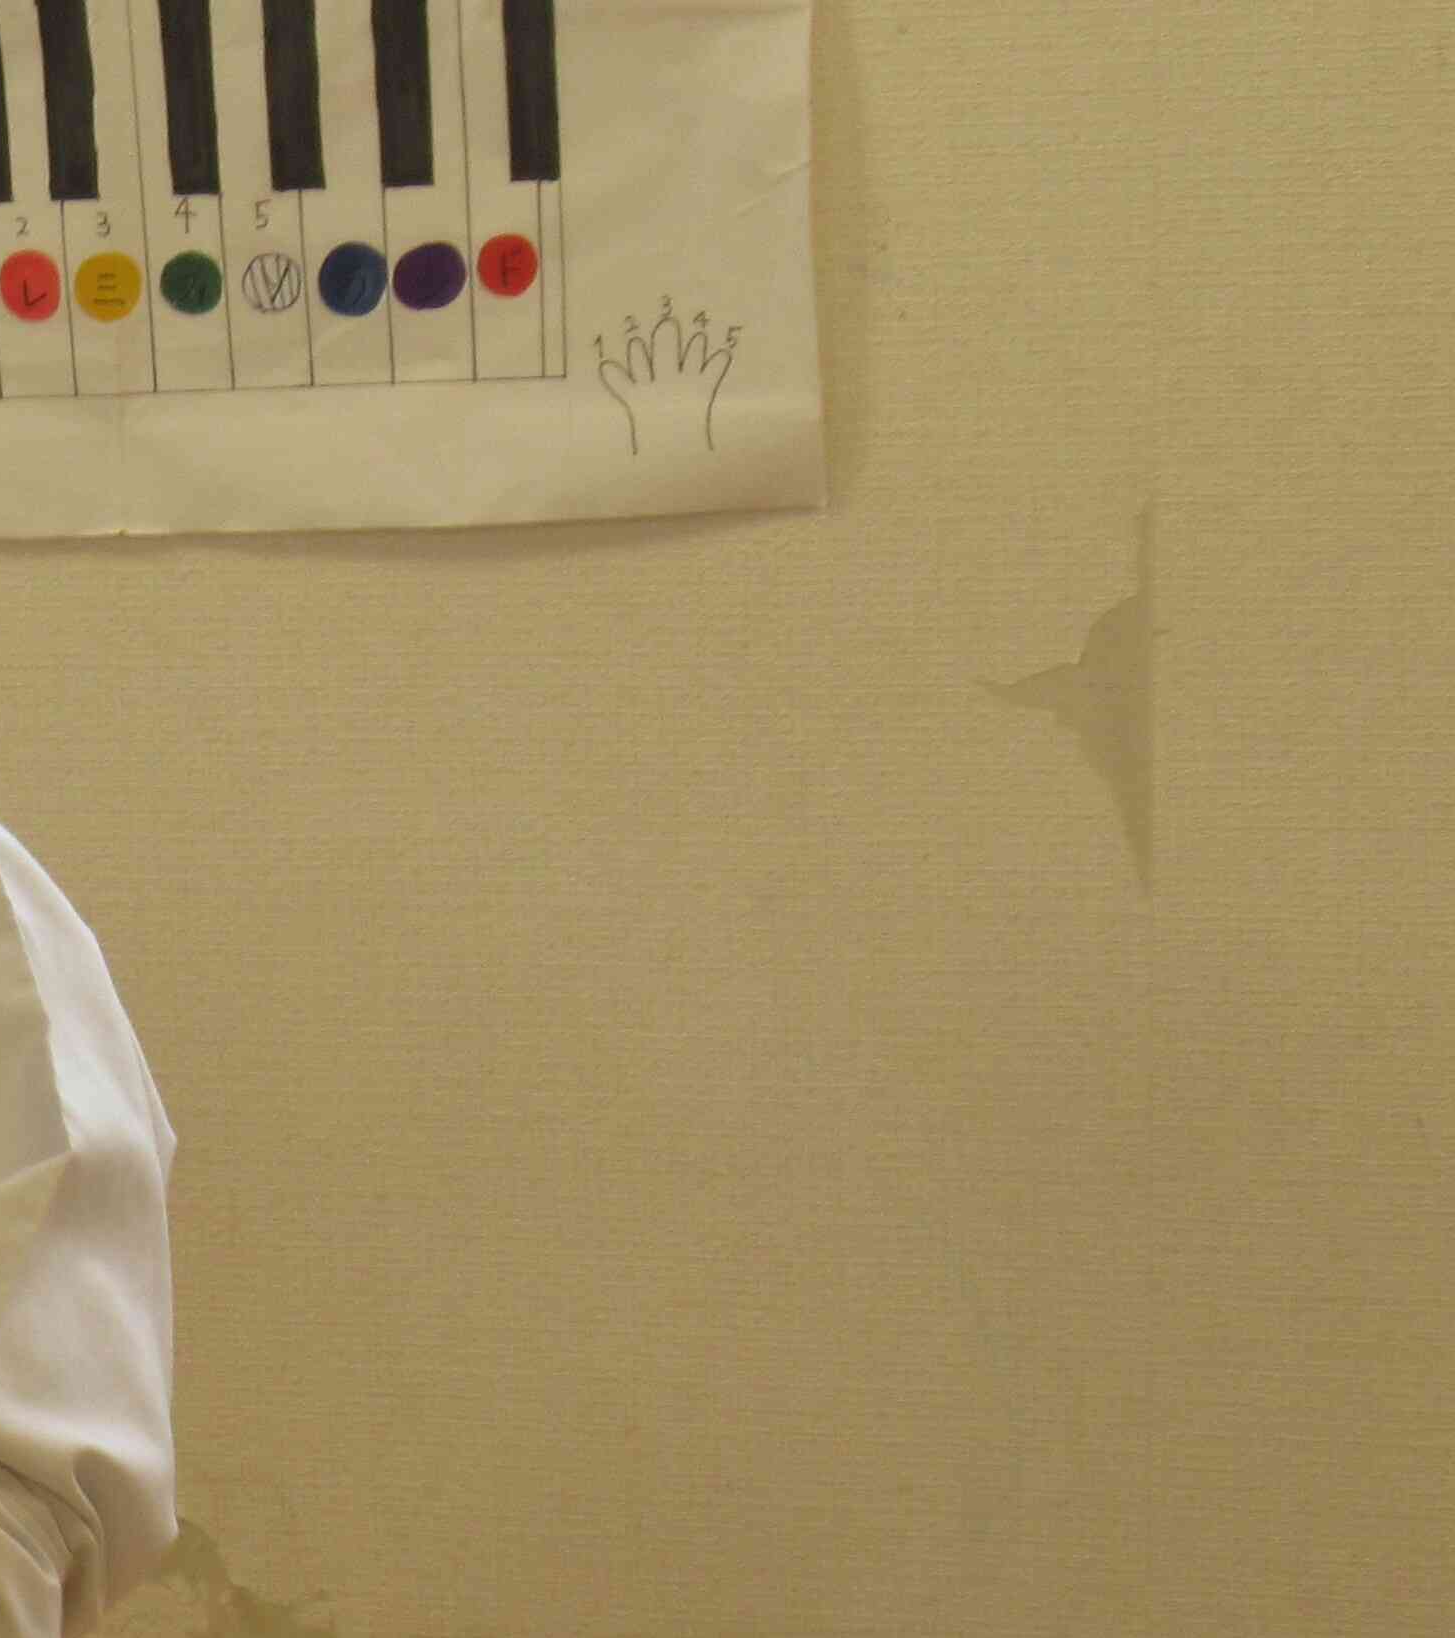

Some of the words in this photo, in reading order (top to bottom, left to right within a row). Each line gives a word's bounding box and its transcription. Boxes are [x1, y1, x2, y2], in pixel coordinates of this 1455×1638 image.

[15, 216, 29, 237] 2
[96, 211, 111, 238] 3
[174, 197, 197, 234] 4
[253, 199, 273, 230] 5
[593, 334, 604, 359] 1
[624, 315, 639, 335] 2
[659, 294, 672, 317] 3
[692, 310, 711, 328] 4
[726, 325, 743, 350] 5
